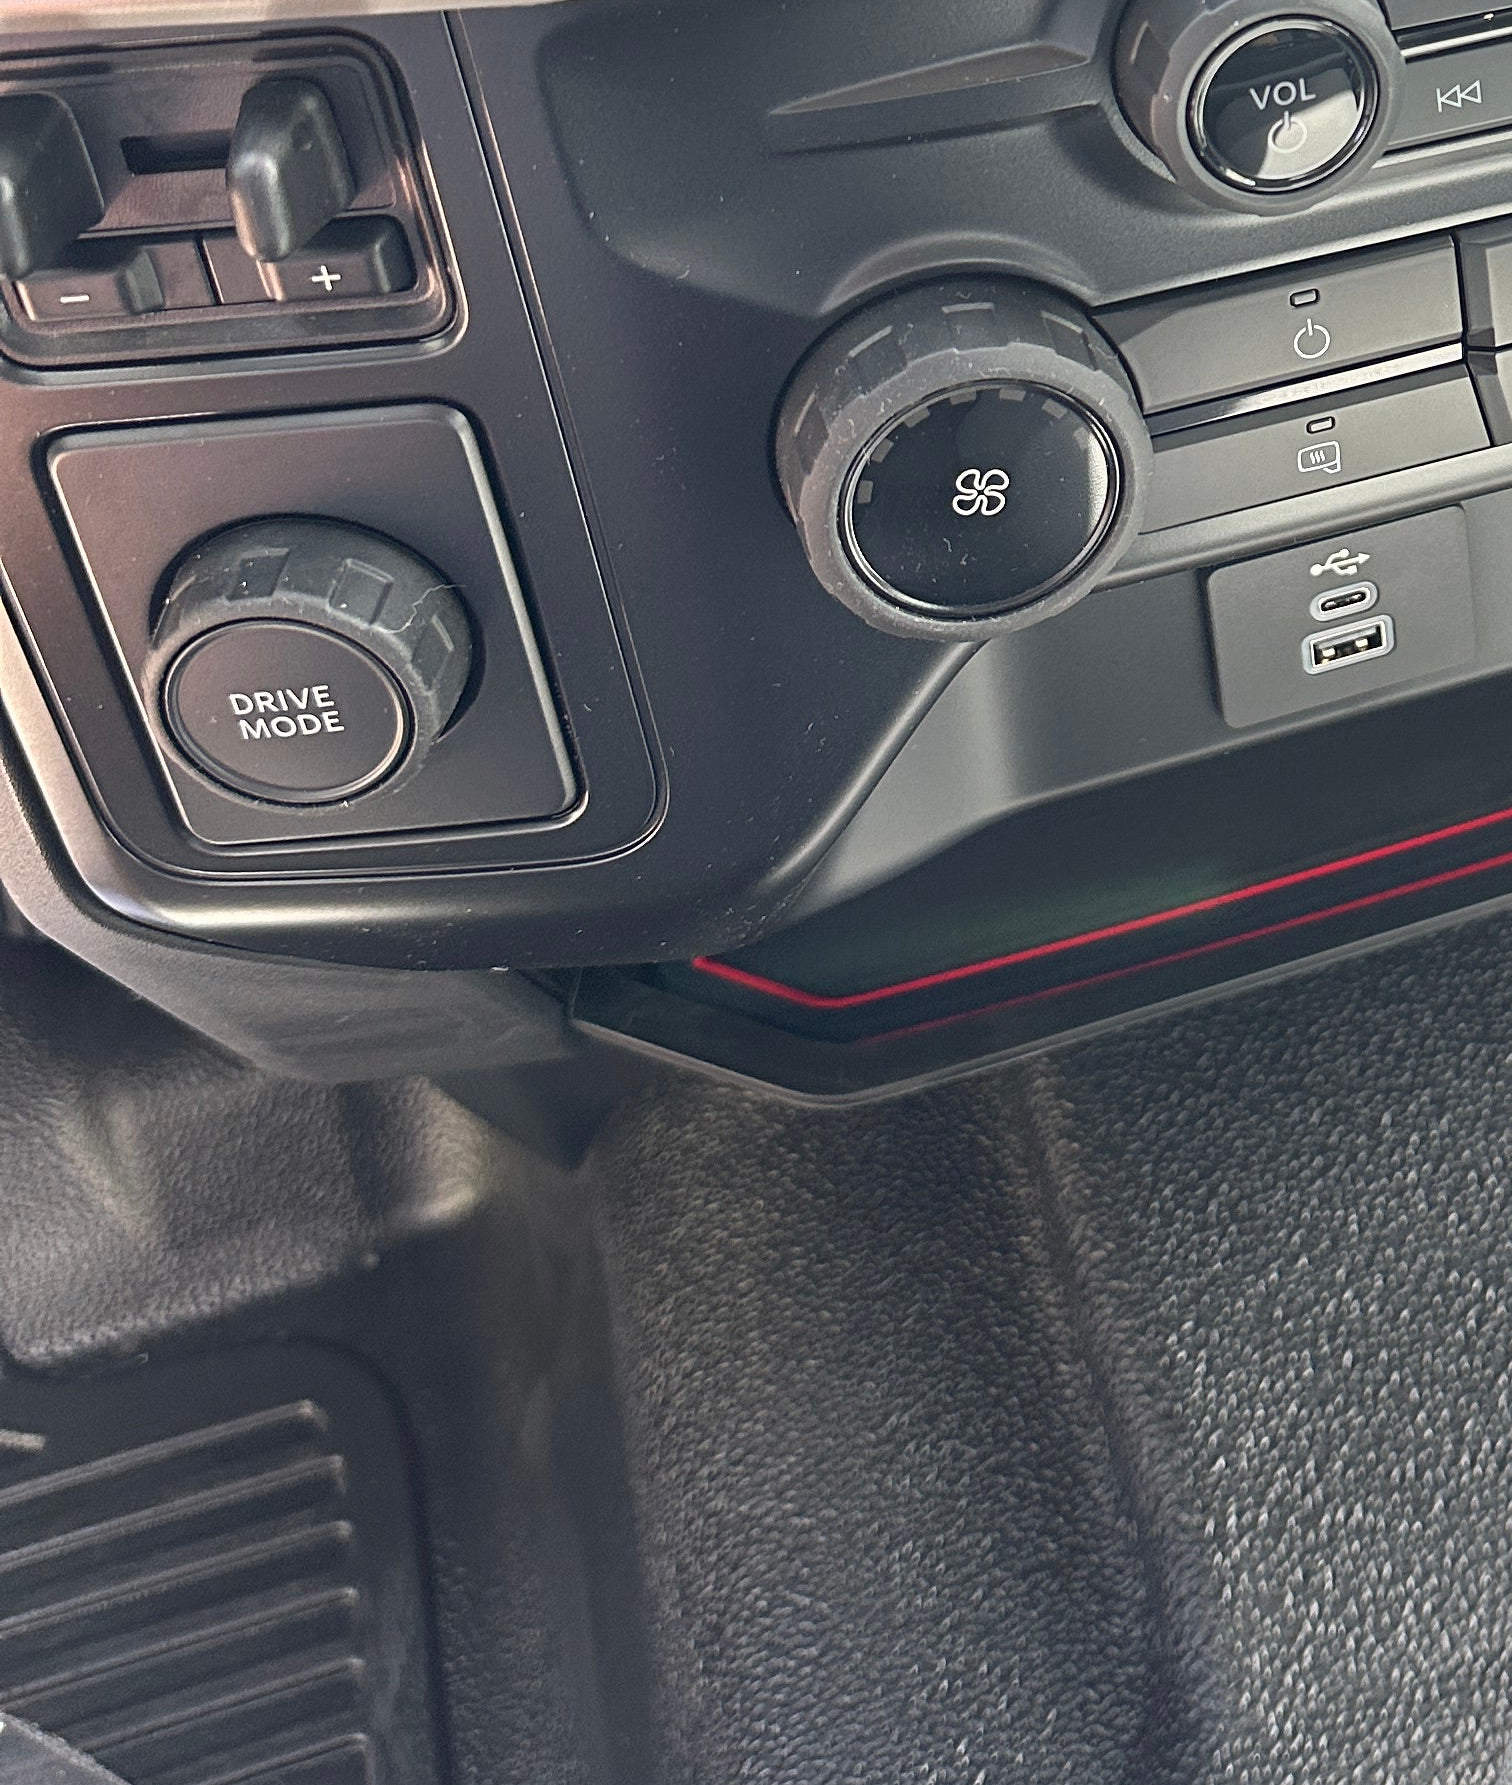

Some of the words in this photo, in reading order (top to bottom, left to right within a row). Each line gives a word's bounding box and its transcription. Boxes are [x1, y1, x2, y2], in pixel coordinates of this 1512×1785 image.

[1249, 77, 1317, 110] VOL
[229, 685, 335, 715] DRIVE
[239, 710, 345, 740] MODE
